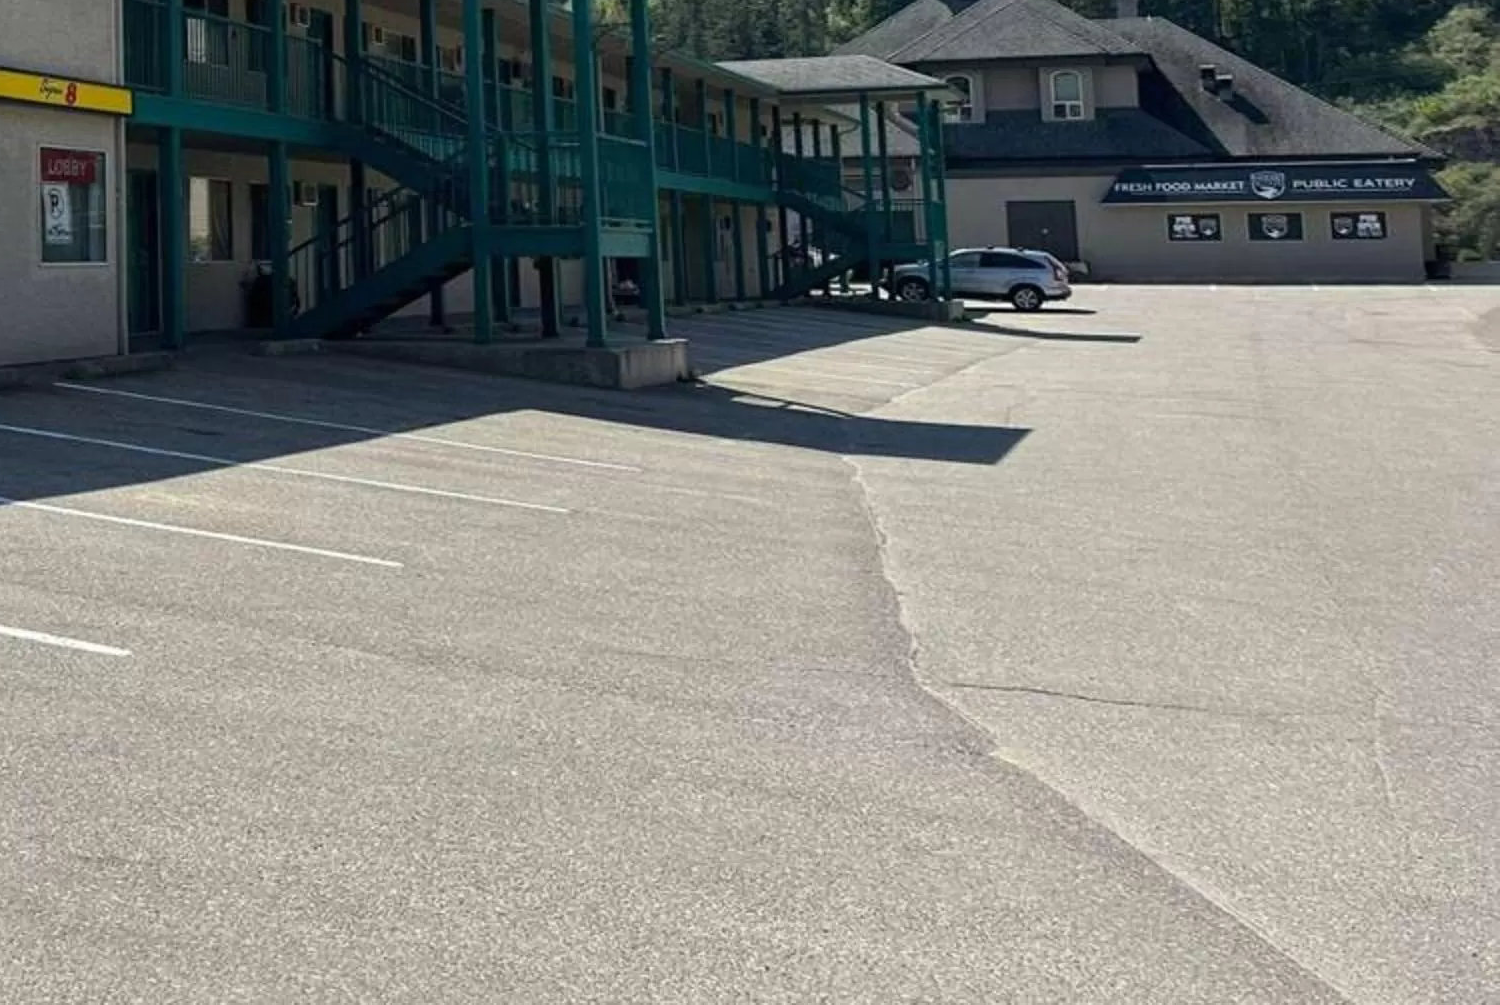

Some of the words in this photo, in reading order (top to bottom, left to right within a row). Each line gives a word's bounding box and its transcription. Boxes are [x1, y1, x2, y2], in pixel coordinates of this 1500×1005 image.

[65, 82, 77, 105] 8
[47, 158, 87, 178] LOBBY
[1114, 182, 1152, 192] FRESH
[1155, 182, 1191, 192] FOOD
[1194, 180, 1245, 191] MARKET
[1292, 178, 1347, 188] PUBLIC
[1353, 178, 1416, 188] EATERY
